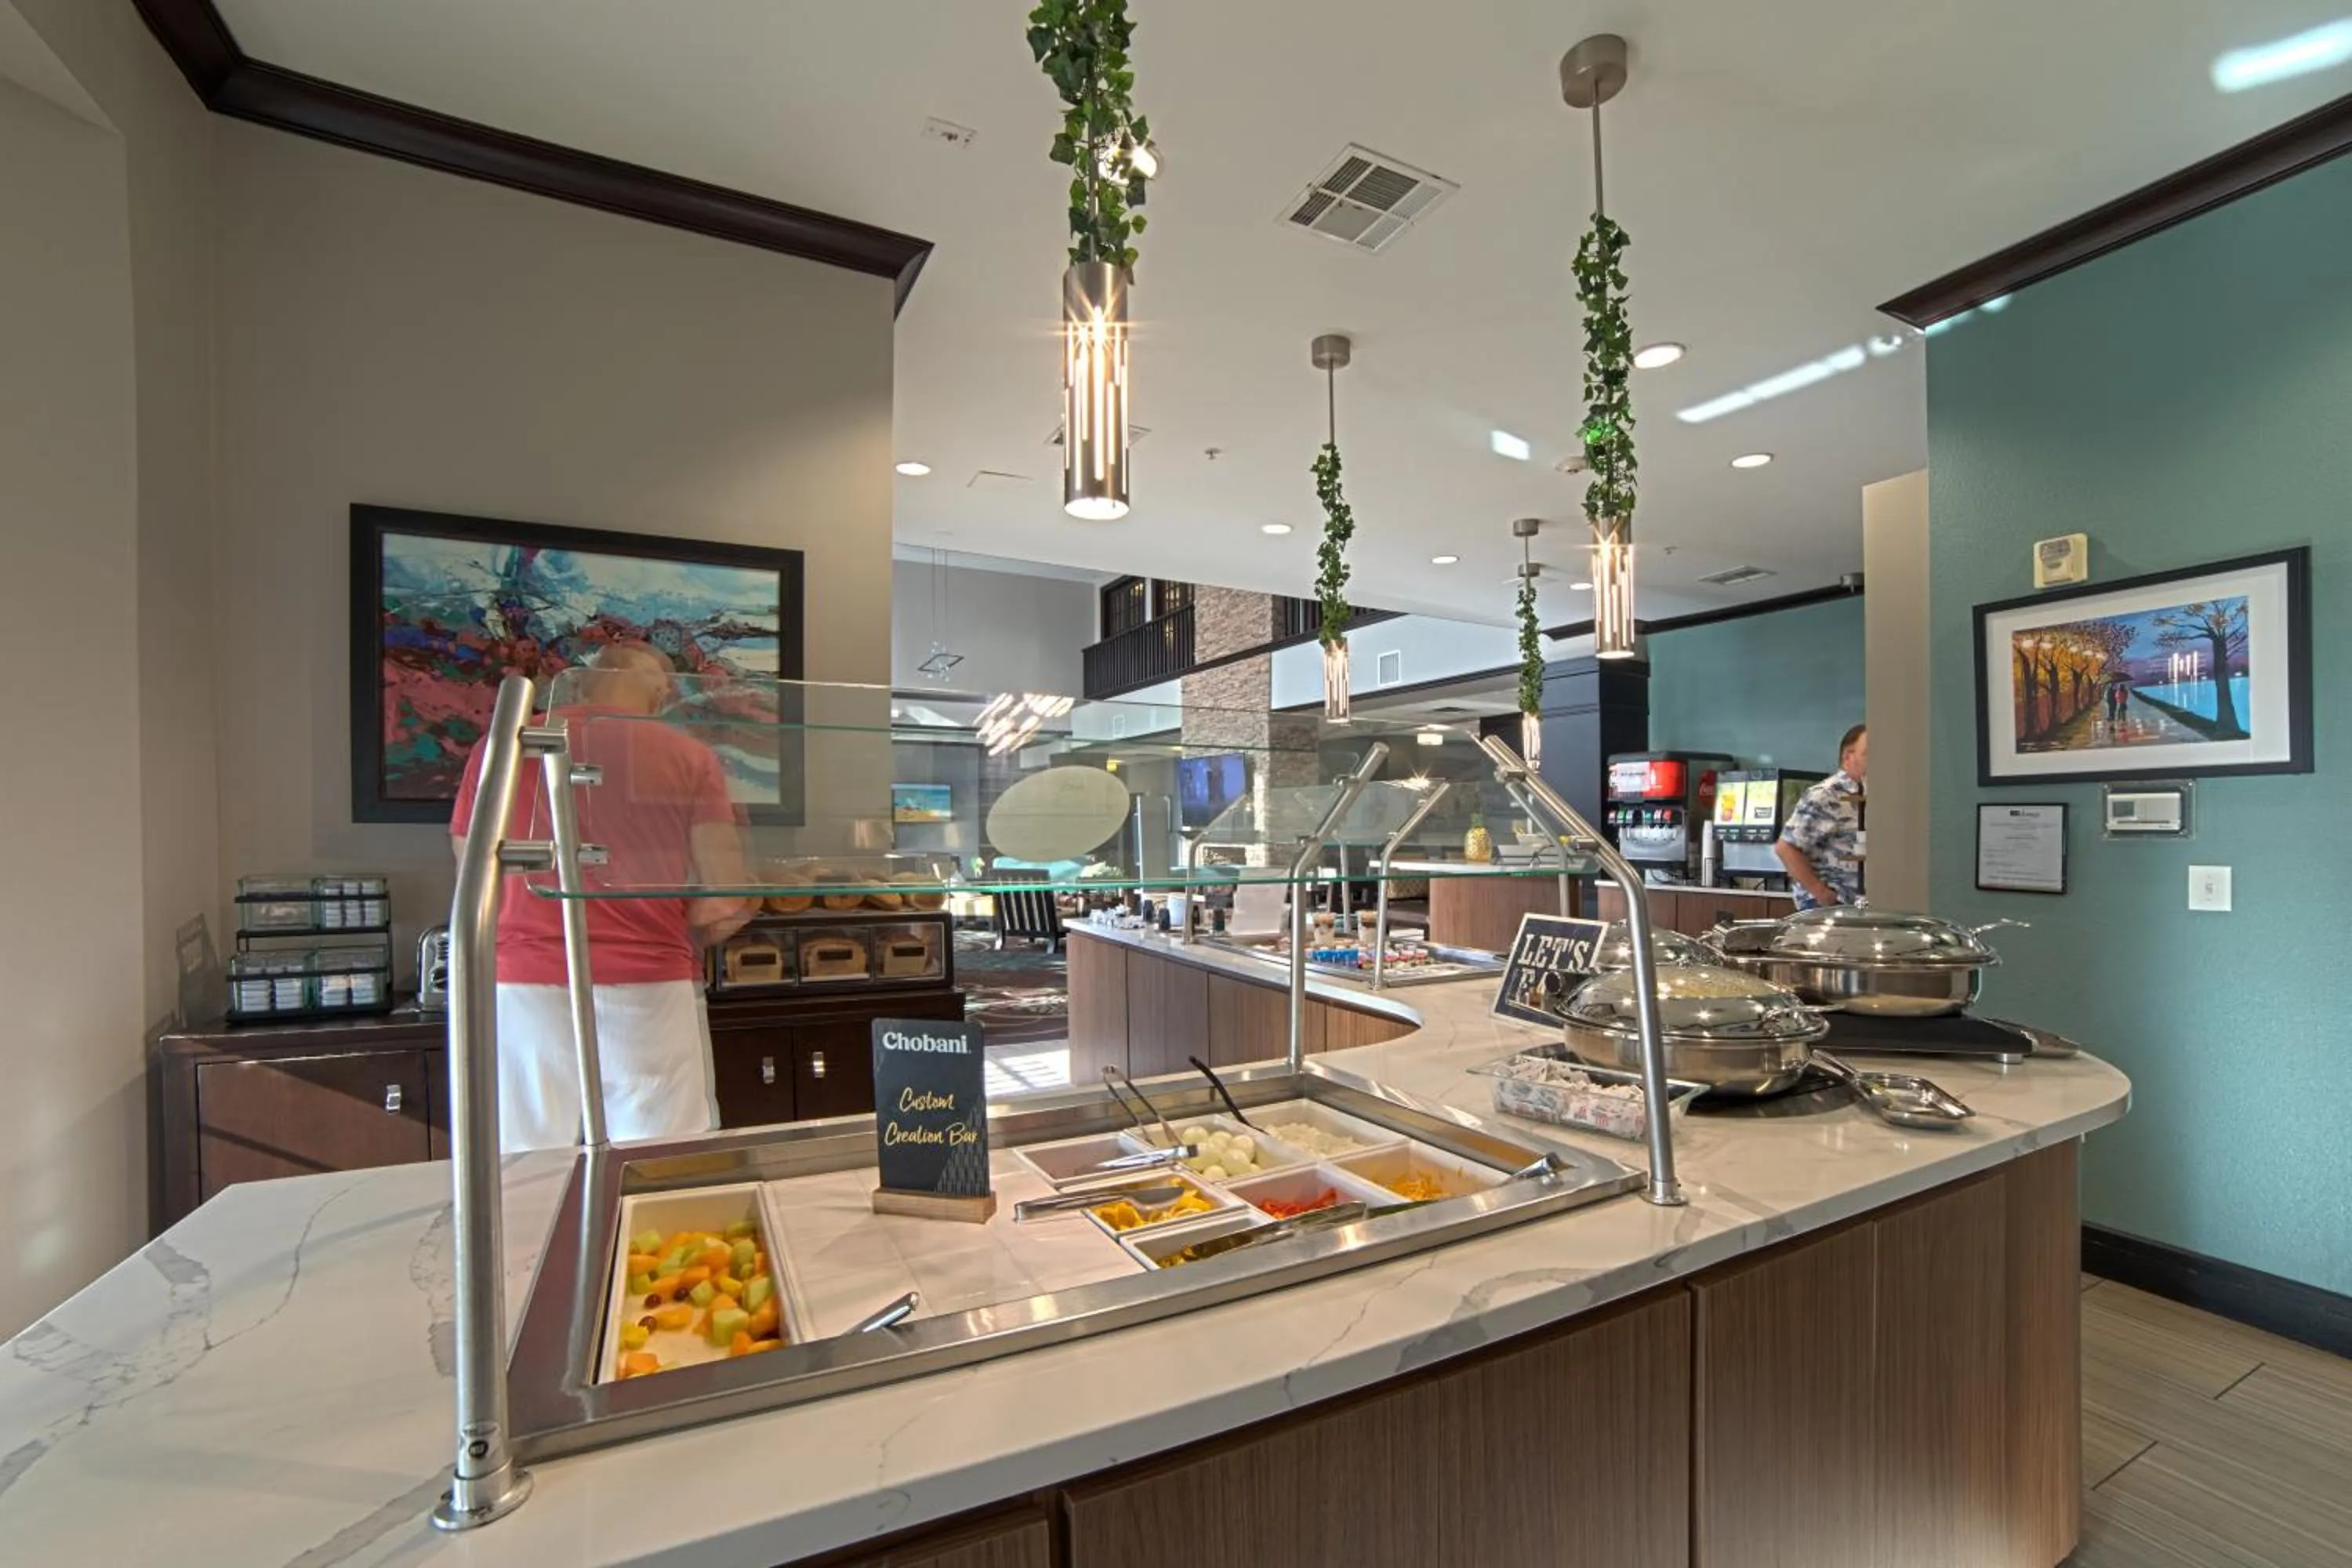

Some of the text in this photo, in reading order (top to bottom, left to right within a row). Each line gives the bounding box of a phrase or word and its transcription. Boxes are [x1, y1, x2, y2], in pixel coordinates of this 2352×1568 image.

[1518, 934, 1592, 973] LET'S
[882, 1031, 968, 1054] Chobani
[898, 1086, 955, 1112] Custom
[884, 1120, 978, 1147] Creation Bar
